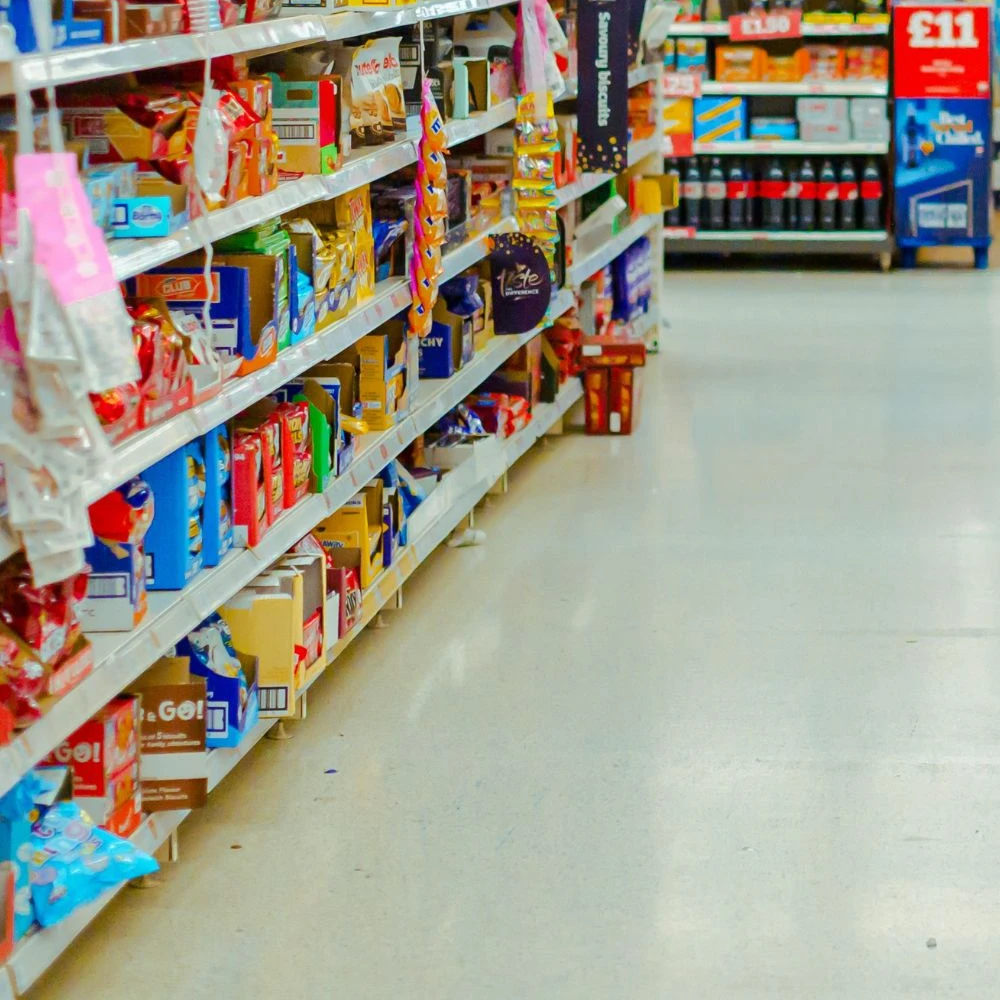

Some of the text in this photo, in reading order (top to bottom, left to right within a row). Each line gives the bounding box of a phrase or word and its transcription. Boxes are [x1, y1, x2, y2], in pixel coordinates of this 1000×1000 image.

[596, 11, 611, 69] Savoury
[907, 11, 979, 48] £11
[597, 70, 611, 127] biscuits
[163, 279, 191, 295] CLUB
[420, 337, 443, 347] CHY
[158, 700, 204, 721] GO!
[54, 740, 100, 763] GO!
